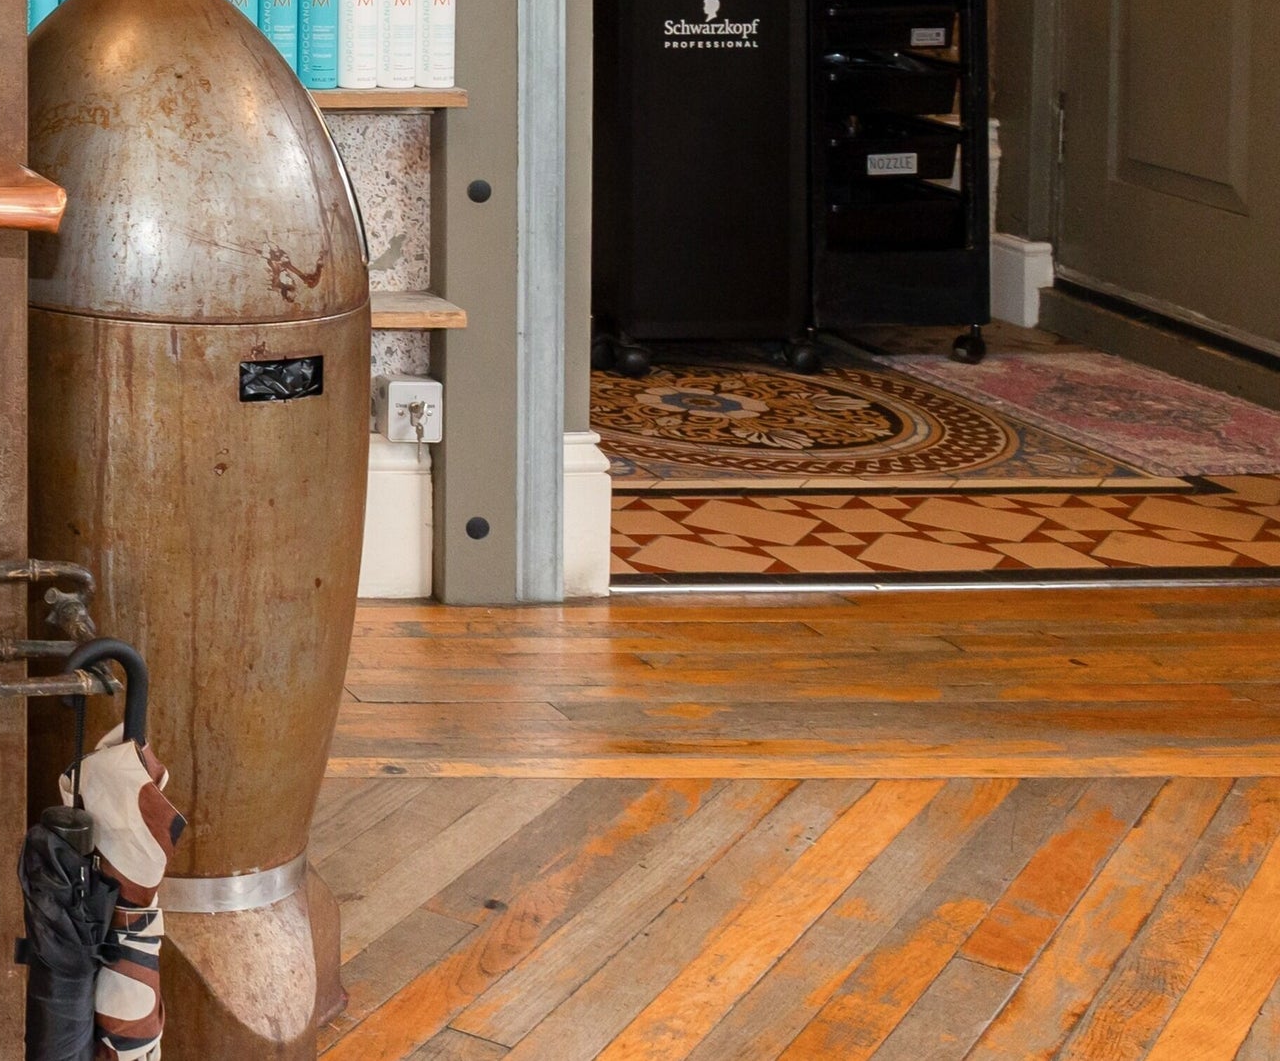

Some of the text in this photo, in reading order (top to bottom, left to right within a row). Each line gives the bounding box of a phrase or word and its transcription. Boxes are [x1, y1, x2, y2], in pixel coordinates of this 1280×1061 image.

[664, 19, 760, 39] Schwarzkopf
[664, 41, 758, 49] PROFESSIONAL
[869, 155, 913, 171] NOZZLE
